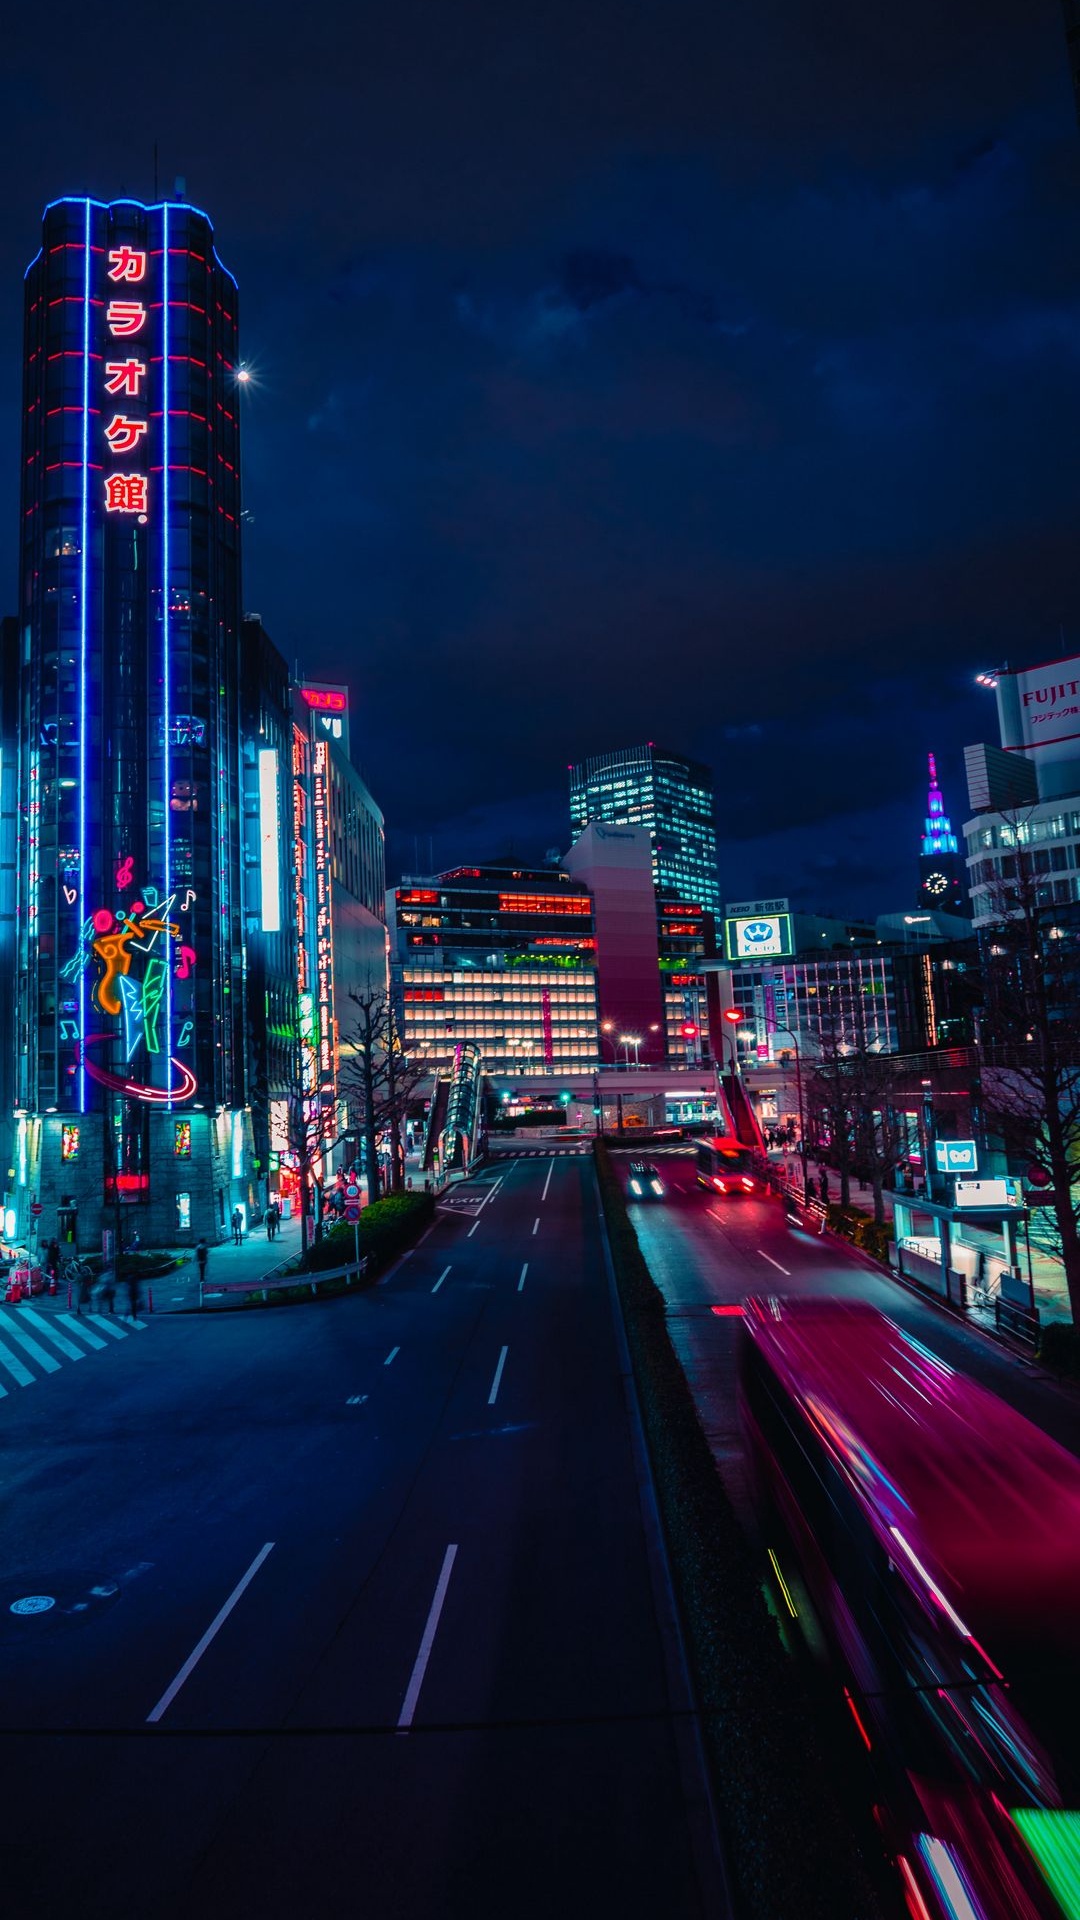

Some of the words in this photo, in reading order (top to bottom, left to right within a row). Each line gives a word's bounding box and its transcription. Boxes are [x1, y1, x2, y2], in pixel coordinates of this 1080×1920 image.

[105, 246, 148, 513] カラオケ館
[1031, 706, 1080, 724] フジテック株
[730, 905, 750, 913] KEIO
